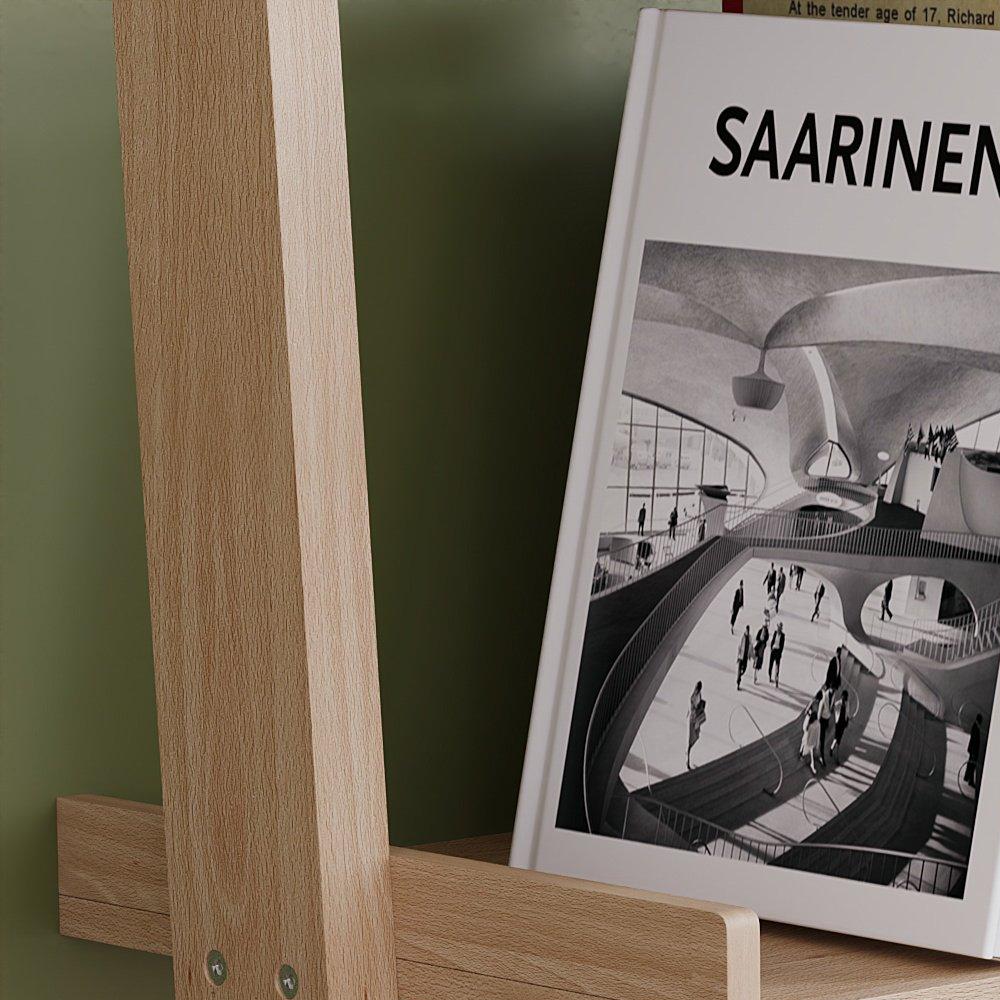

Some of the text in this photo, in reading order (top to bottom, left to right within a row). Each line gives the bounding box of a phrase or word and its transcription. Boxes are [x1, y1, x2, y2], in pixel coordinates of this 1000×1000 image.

[788, 0, 802, 15] At
[807, 2, 827, 16] the
[831, 3, 870, 19] tender
[876, 7, 899, 23] age
[904, 7, 917, 21] of
[922, 7, 941, 25] 17,
[947, 8, 995, 26] Richard
